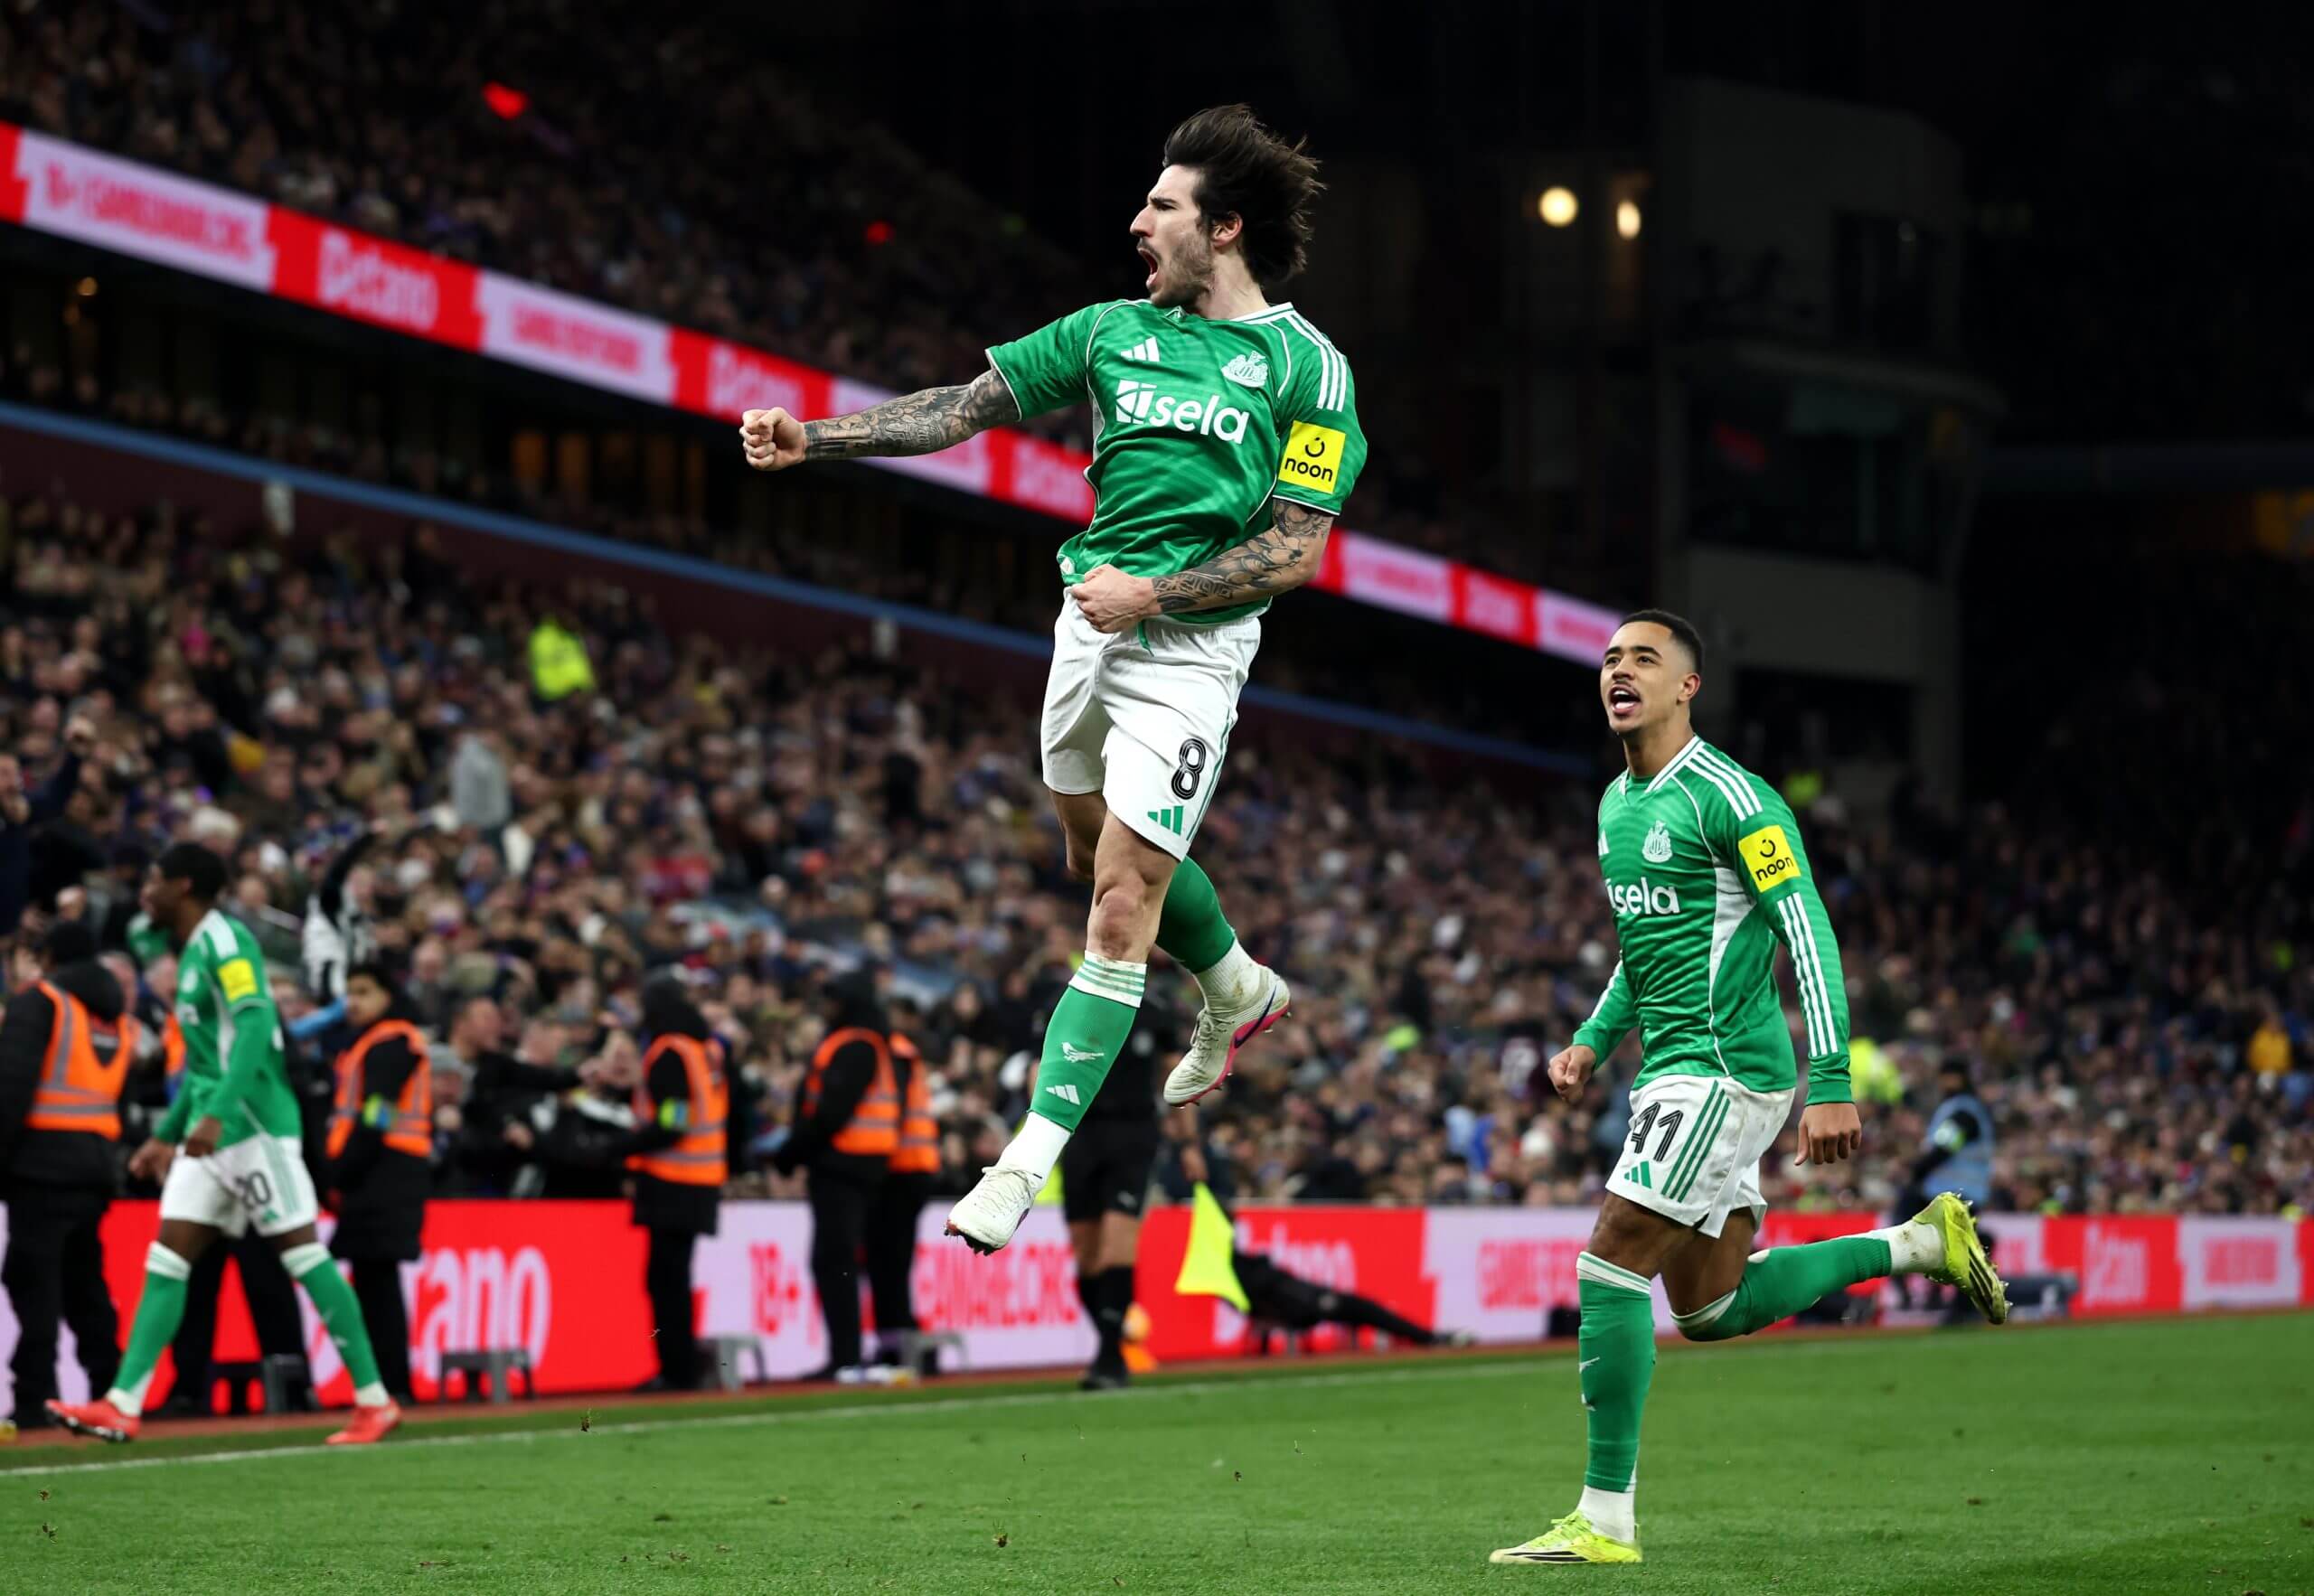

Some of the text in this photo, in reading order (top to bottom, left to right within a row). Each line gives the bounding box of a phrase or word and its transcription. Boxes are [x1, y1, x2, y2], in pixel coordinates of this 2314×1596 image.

[1149, 395, 1249, 444] sela
[1284, 457, 1333, 482] noon
[1171, 738, 1207, 800] 8
[1754, 857, 1794, 881] noon
[1614, 876, 1681, 915] sela
